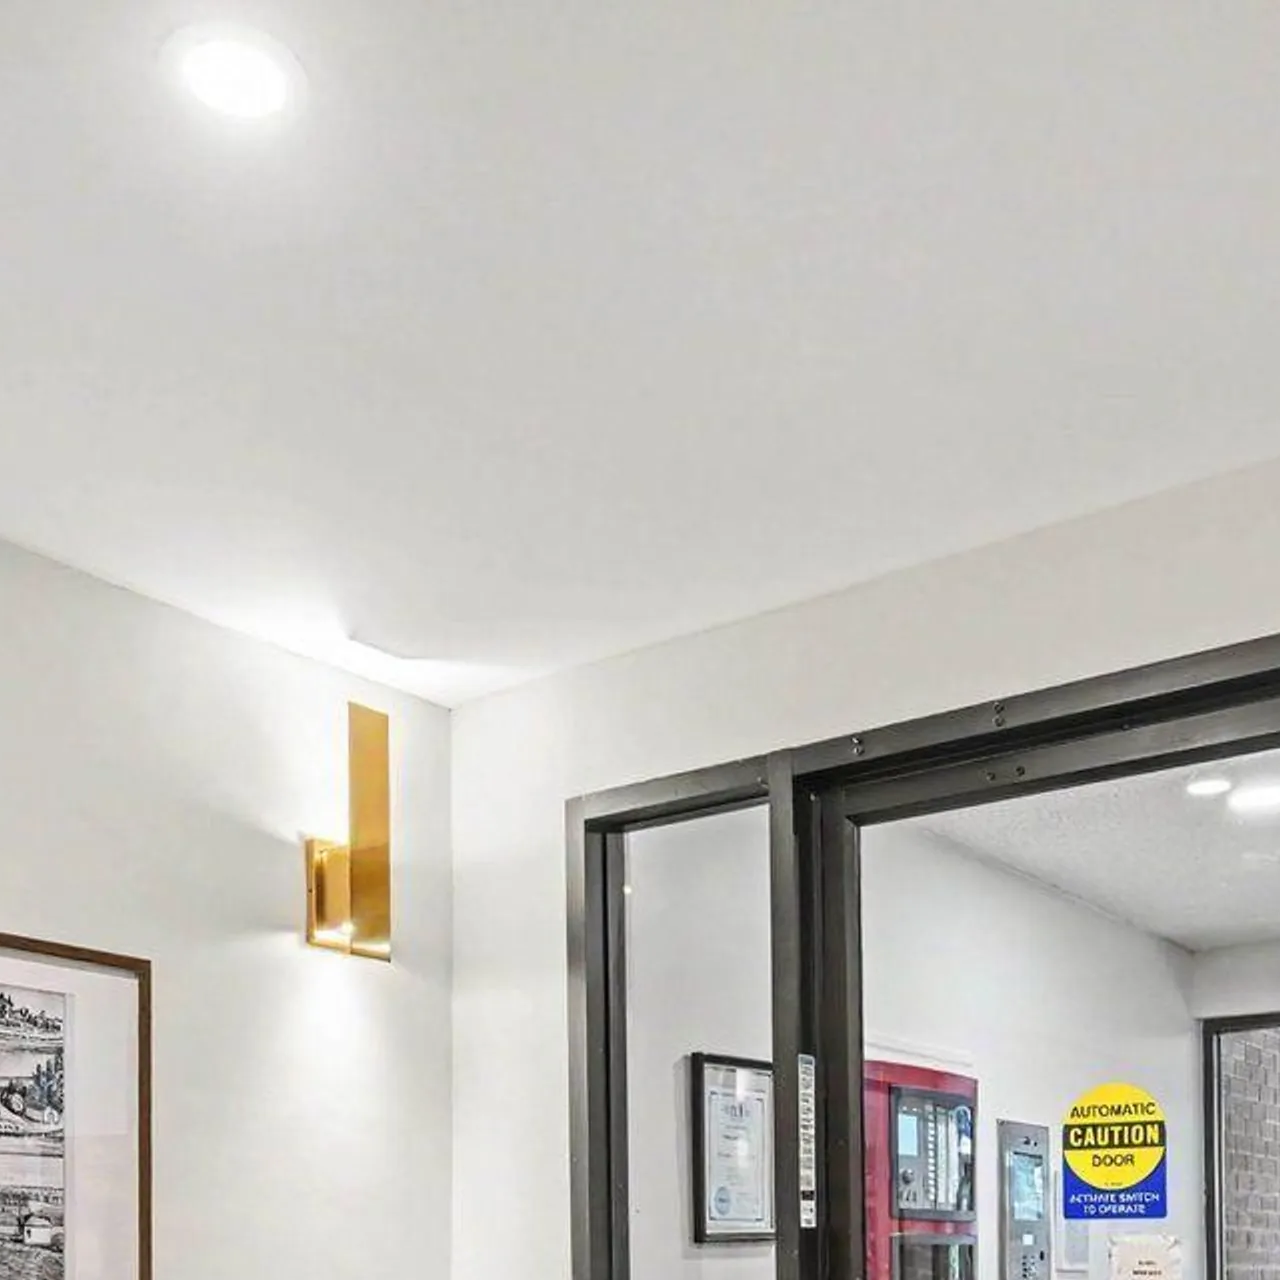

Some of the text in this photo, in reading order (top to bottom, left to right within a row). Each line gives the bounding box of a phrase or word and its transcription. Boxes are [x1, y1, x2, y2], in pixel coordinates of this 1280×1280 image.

[1070, 1102, 1156, 1119] AUTOMATIC
[1069, 1124, 1159, 1147] CAUTION
[1092, 1153, 1135, 1167] DOOR
[1119, 1191, 1160, 1203] SWITCH
[1084, 1203, 1147, 1215] TO OPERATE
